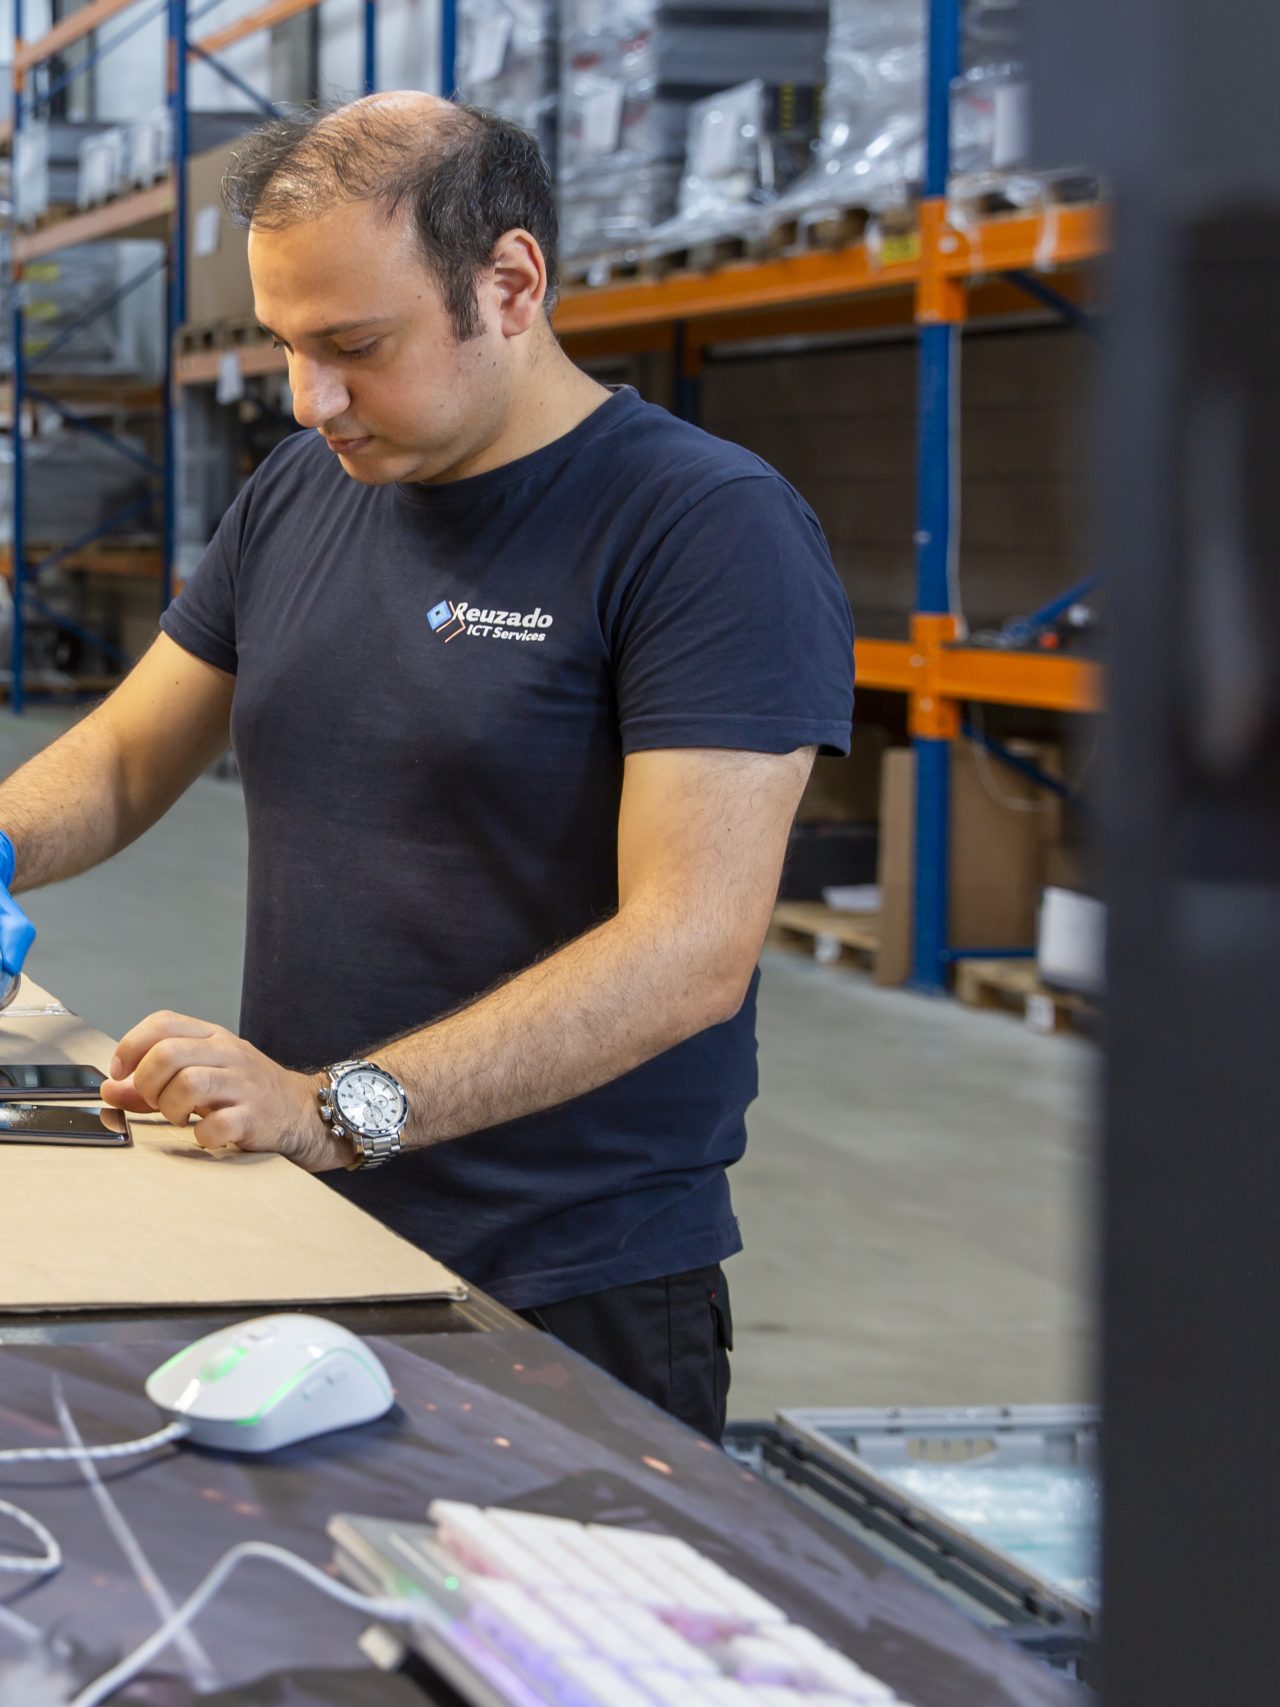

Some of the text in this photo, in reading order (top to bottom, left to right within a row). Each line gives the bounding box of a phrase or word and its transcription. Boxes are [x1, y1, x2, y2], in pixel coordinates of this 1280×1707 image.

[451, 601, 554, 628] Reuzado
[466, 624, 547, 642] ICT Services
